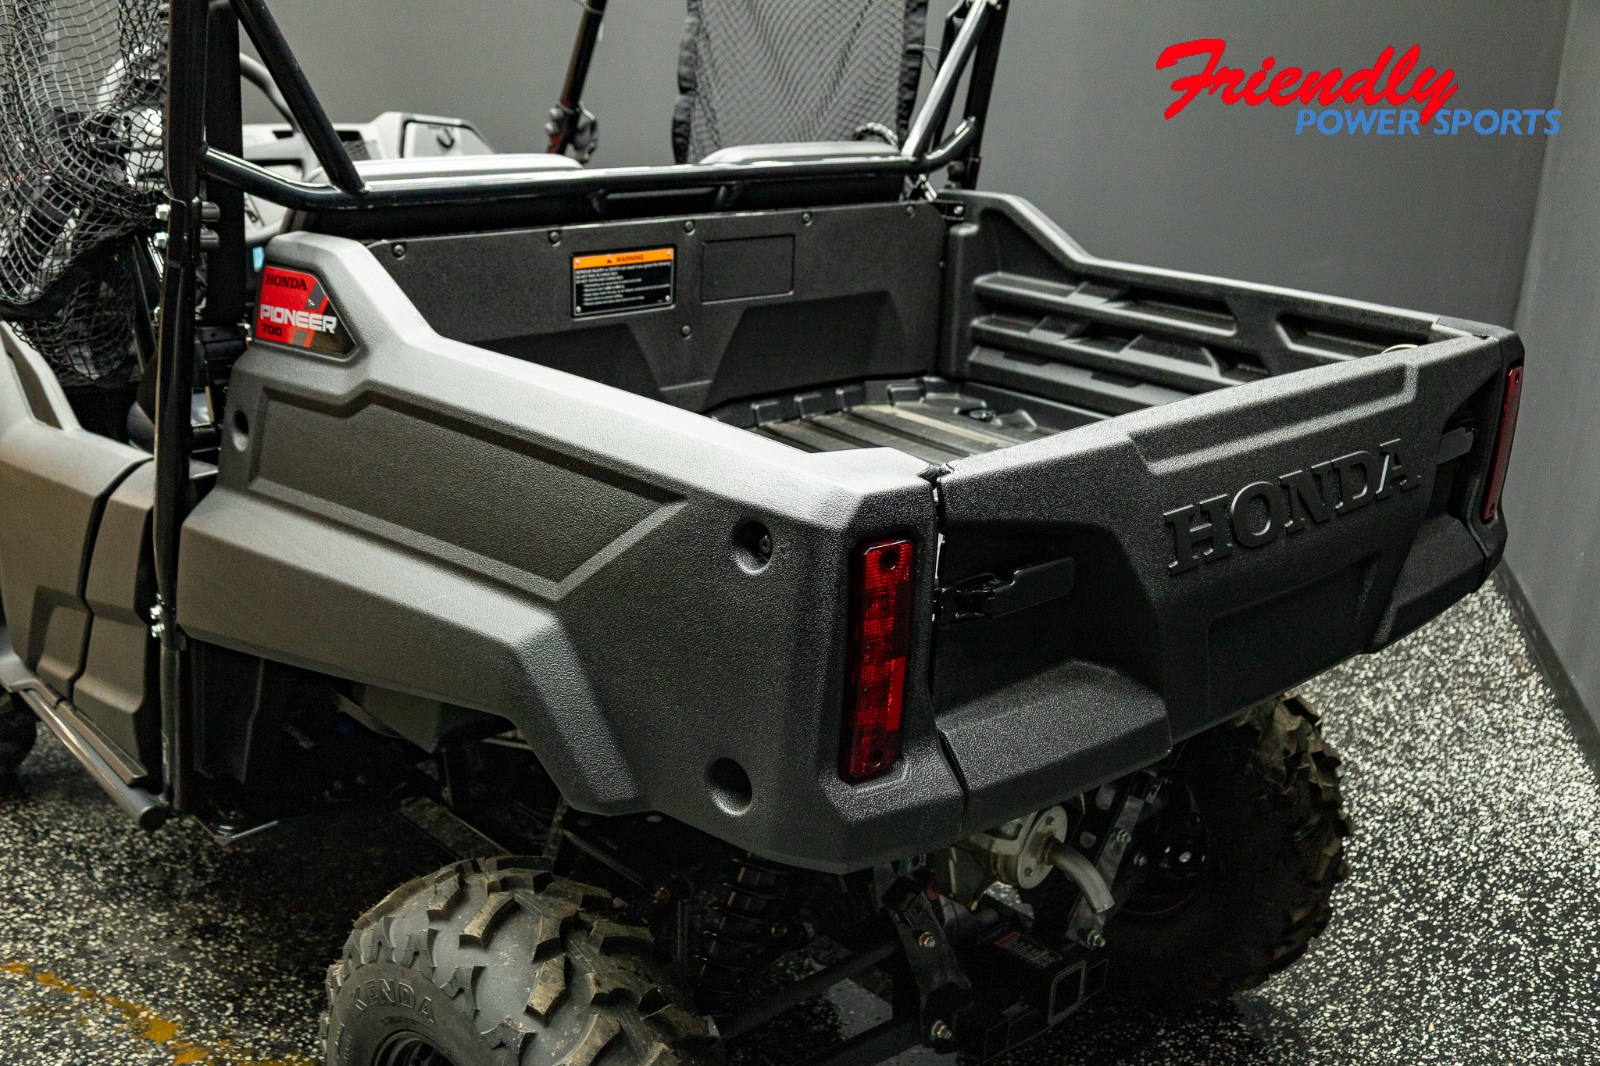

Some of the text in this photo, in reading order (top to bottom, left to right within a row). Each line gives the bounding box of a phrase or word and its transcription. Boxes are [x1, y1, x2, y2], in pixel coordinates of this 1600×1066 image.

[616, 254, 645, 263] WARNING
[265, 274, 308, 291] HONDA
[260, 303, 337, 334] PIONEER
[261, 323, 282, 337] 700
[1163, 438, 1422, 576] HONDA
[349, 978, 436, 1024] KENDA
